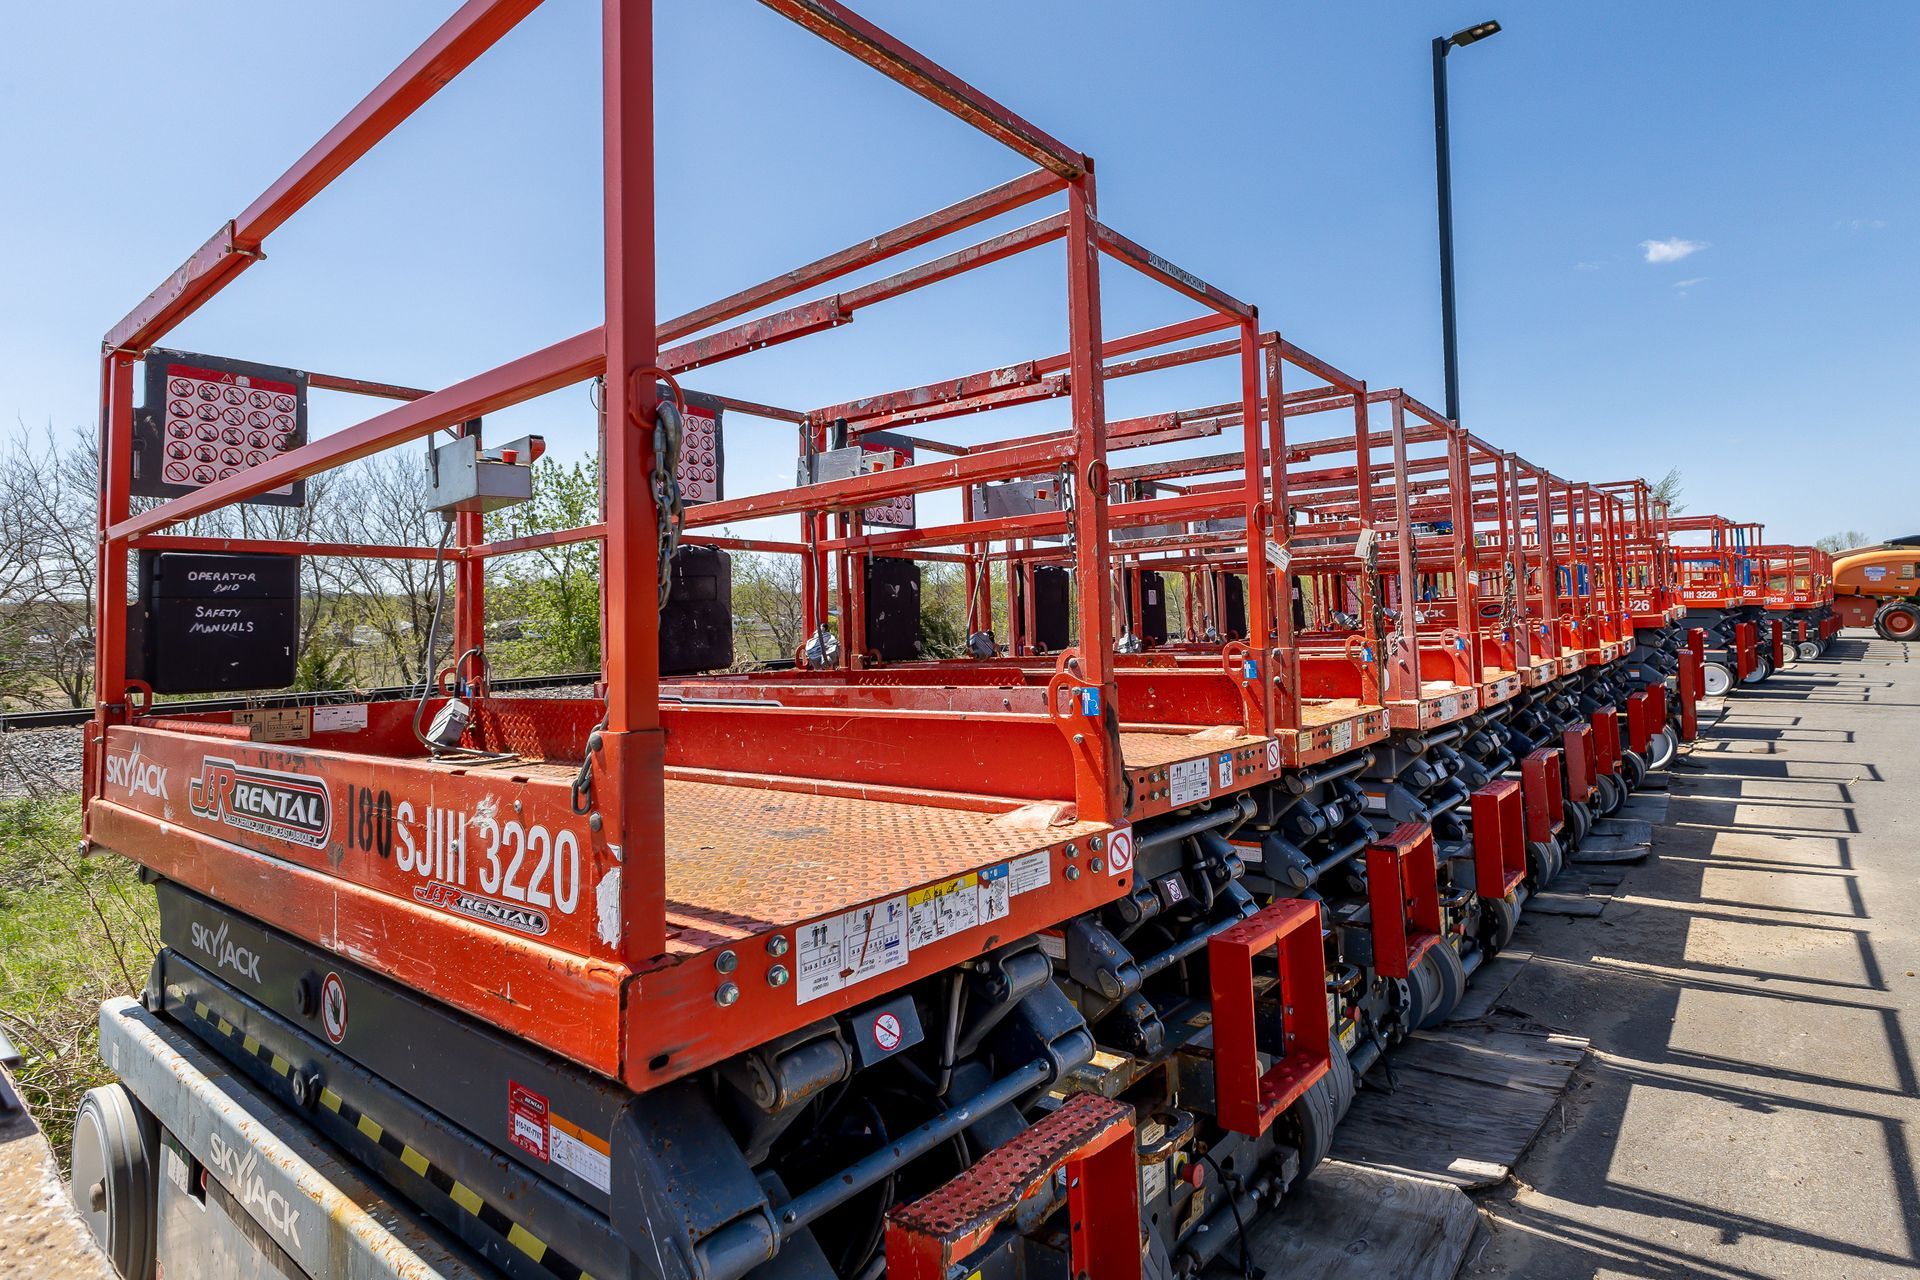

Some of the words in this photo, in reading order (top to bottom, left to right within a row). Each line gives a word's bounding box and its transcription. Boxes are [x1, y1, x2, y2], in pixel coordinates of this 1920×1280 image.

[188, 571, 256, 582] OPERATOR
[1696, 591, 1718, 599] 3226
[189, 621, 254, 634] MANUALS
[195, 605, 242, 618] SAFETY
[106, 741, 169, 800] SKYJACK
[235, 784, 323, 827] RENTAL
[348, 783, 392, 859] 180
[479, 814, 580, 915] 3220
[460, 897, 542, 929] RENTAL
[191, 920, 262, 984] SKYJACK
[210, 1132, 301, 1249] SKYJACK
